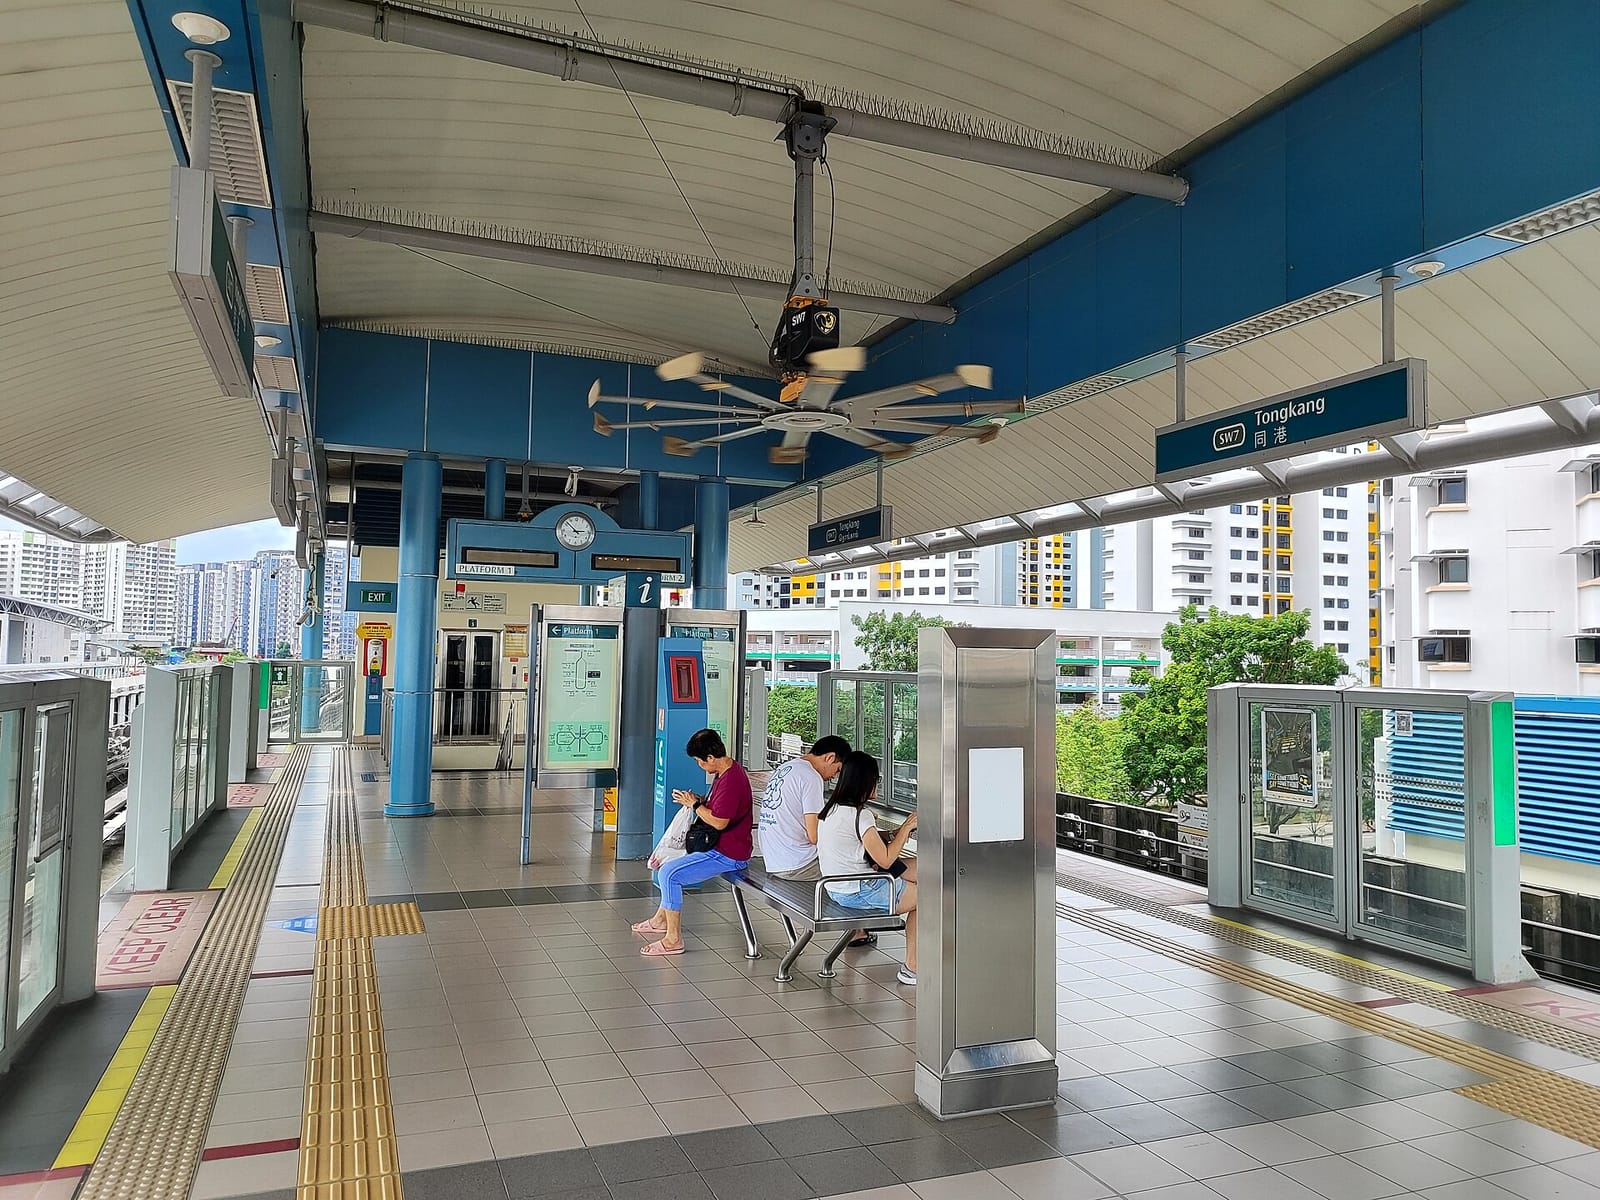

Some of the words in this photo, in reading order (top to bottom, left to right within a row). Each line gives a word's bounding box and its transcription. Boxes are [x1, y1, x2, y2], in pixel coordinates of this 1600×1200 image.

[791, 311, 806, 327] SW7
[1254, 397, 1325, 426] Tongkang
[1219, 429, 1240, 445] SW7
[1254, 425, 1287, 448] 同港
[459, 564, 505, 575] PLATFORM
[507, 566, 513, 575] 1
[368, 592, 386, 602] EXIT
[563, 627, 593, 635] Platform
[685, 629, 712, 638] Platform
[132, 897, 194, 935] CLEAR
[99, 937, 168, 977] KEEP
